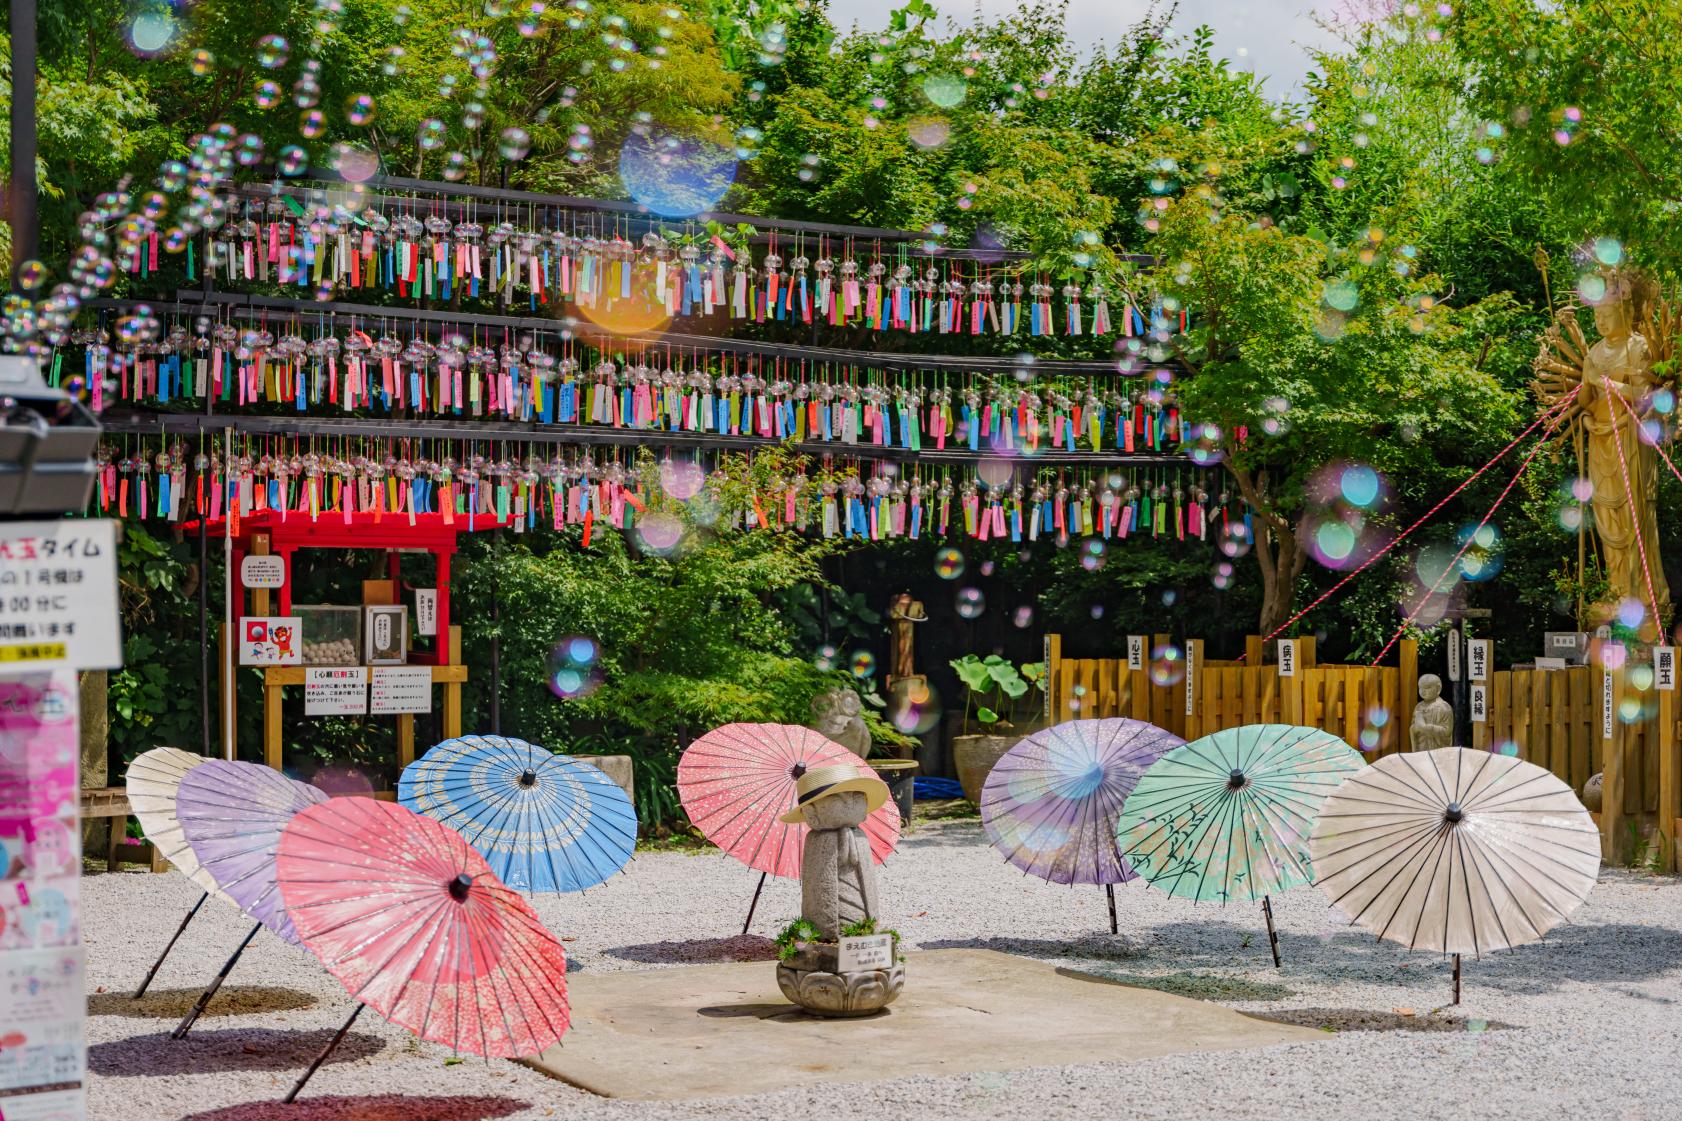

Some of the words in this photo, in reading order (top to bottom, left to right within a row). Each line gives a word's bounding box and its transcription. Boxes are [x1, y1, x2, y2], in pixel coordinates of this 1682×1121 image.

[1132, 639, 1140, 665] 心玉
[1283, 644, 1291, 672] 病玉
[1473, 646, 1484, 676] 縁玉
[1659, 652, 1672, 685] 願玉
[1474, 690, 1484, 716] 良縁
